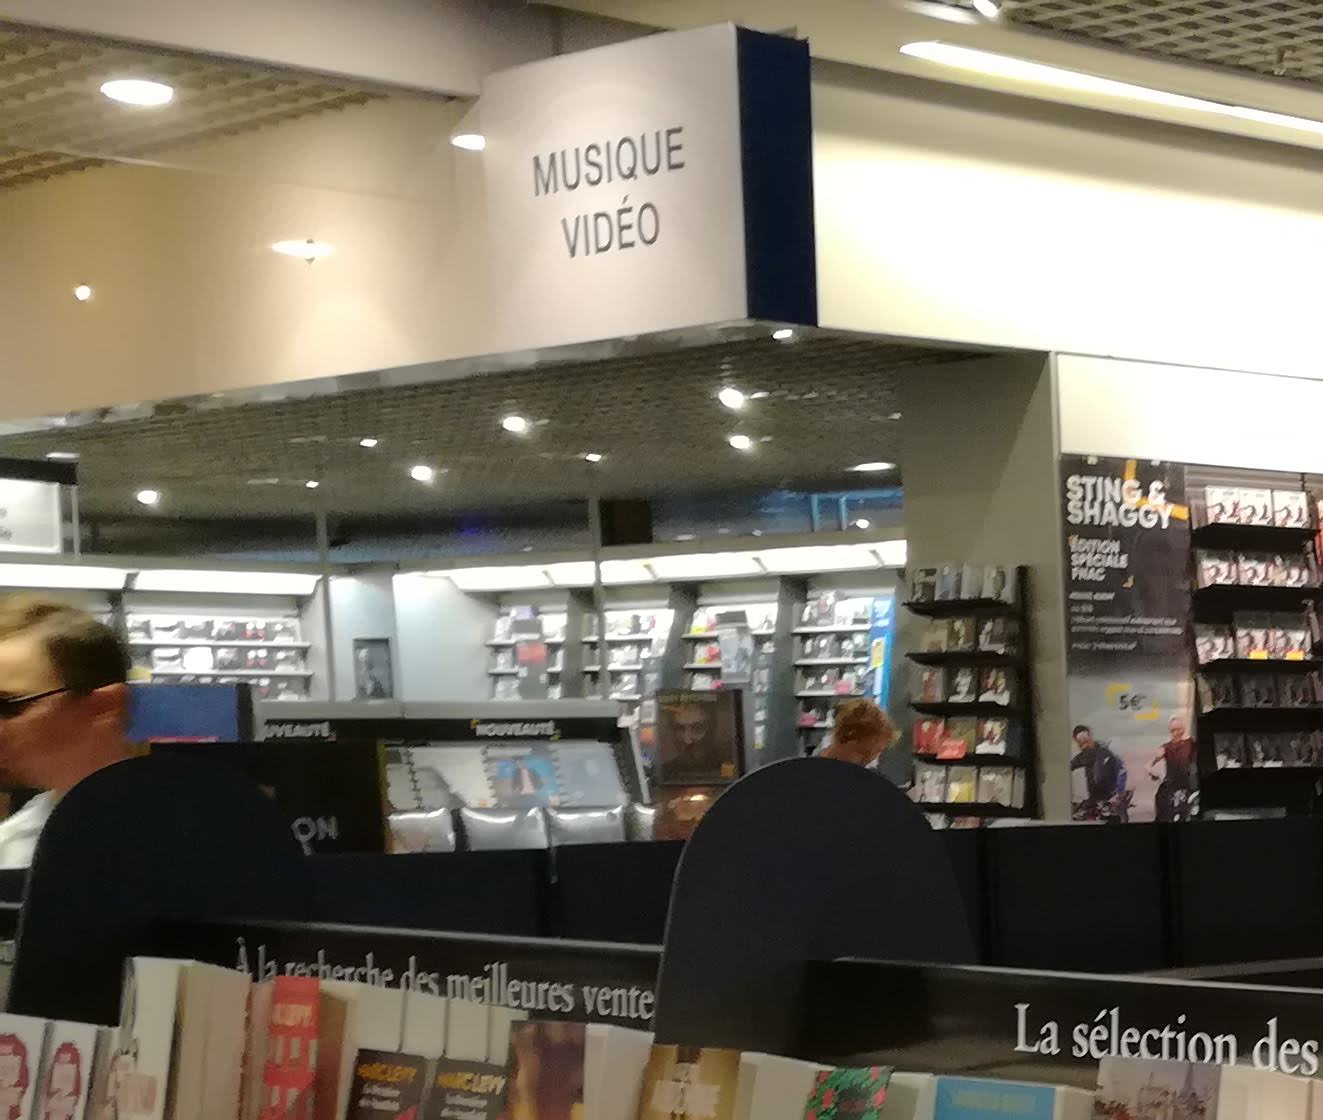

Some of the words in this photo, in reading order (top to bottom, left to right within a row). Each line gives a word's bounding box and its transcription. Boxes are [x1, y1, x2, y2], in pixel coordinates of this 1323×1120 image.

[533, 126, 686, 196] MUSIQUE
[561, 197, 661, 259] VIDÉO
[1066, 474, 1142, 506] STING
[1147, 480, 1166, 507] &
[1067, 500, 1174, 529] SHAGGY
[285, 947, 394, 989] recherche
[400, 955, 440, 997] des
[445, 962, 575, 1013] meilleures
[581, 984, 656, 1021] vente
[1013, 1003, 1061, 1056] La
[1072, 1007, 1238, 1067] sélection
[1253, 1018, 1319, 1076] des
